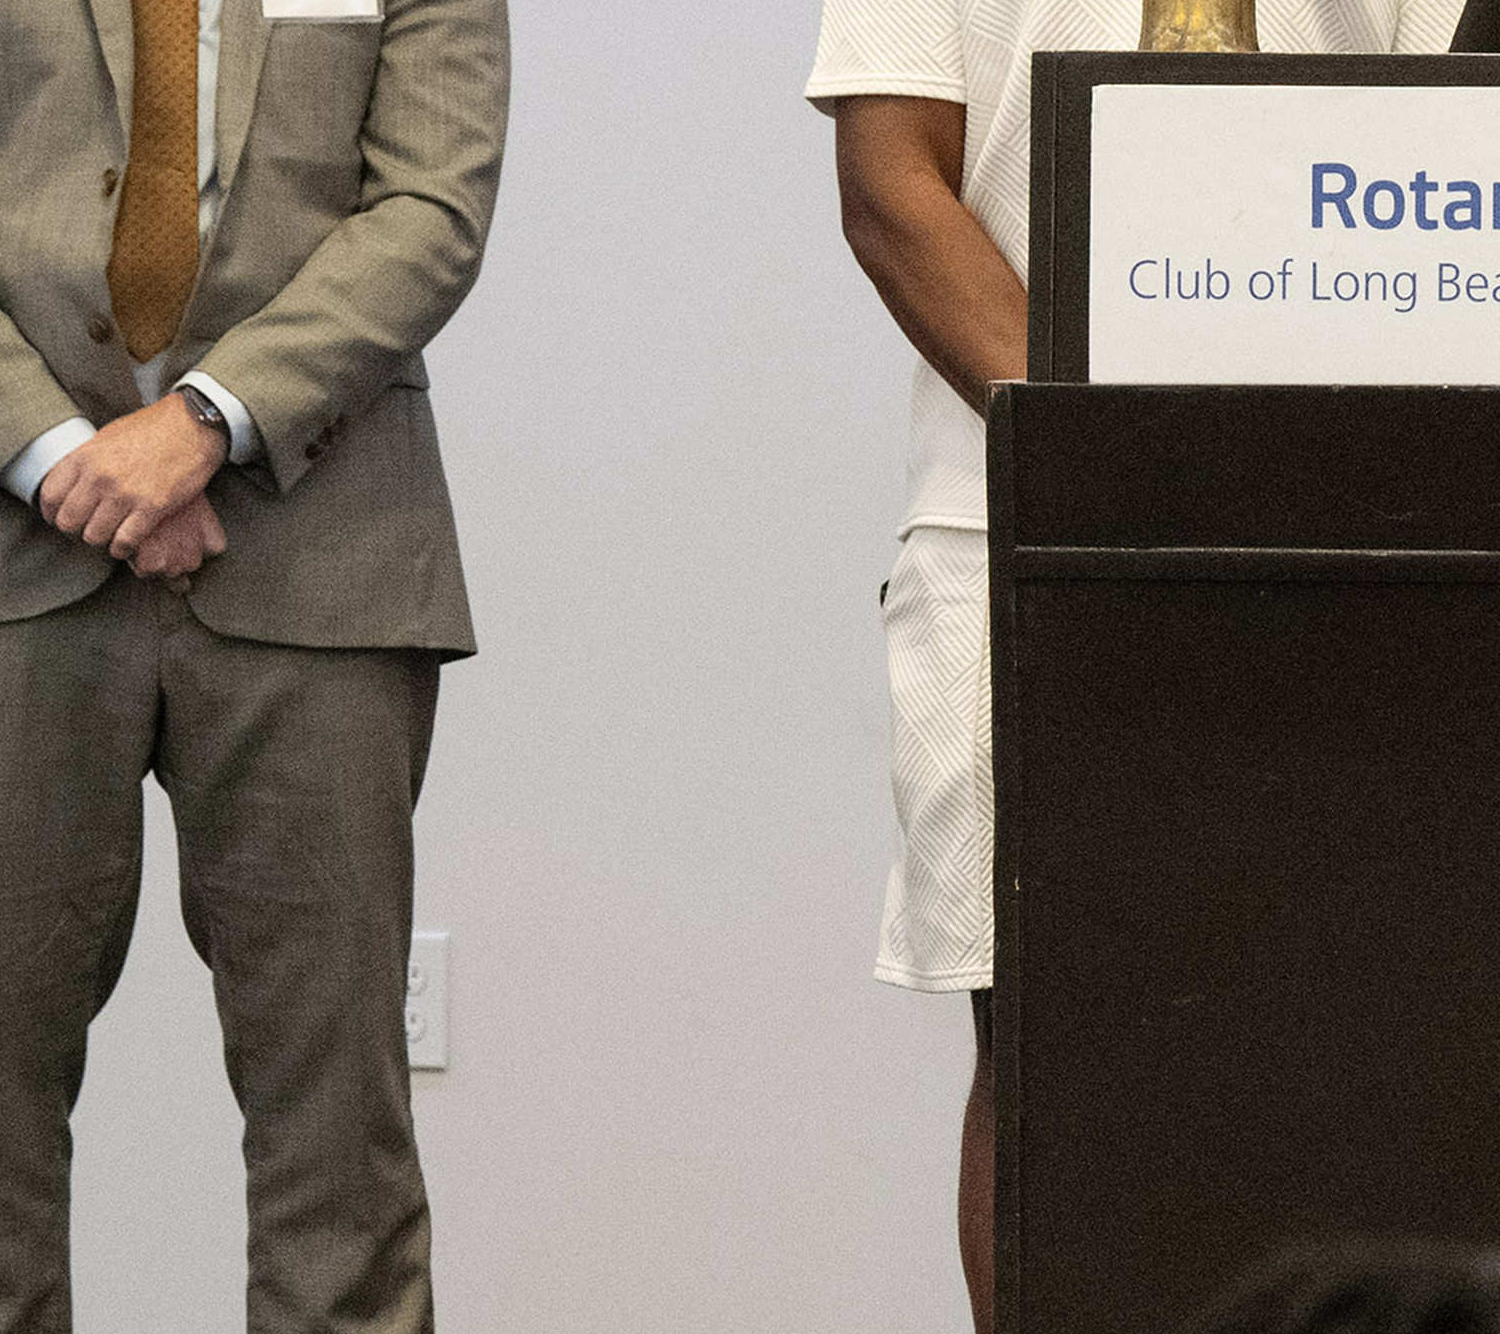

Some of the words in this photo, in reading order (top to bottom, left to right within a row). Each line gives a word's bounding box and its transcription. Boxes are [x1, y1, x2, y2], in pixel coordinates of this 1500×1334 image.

[1128, 258, 1231, 301] Club
[1247, 258, 1294, 302] of
[1310, 262, 1417, 313] Long
